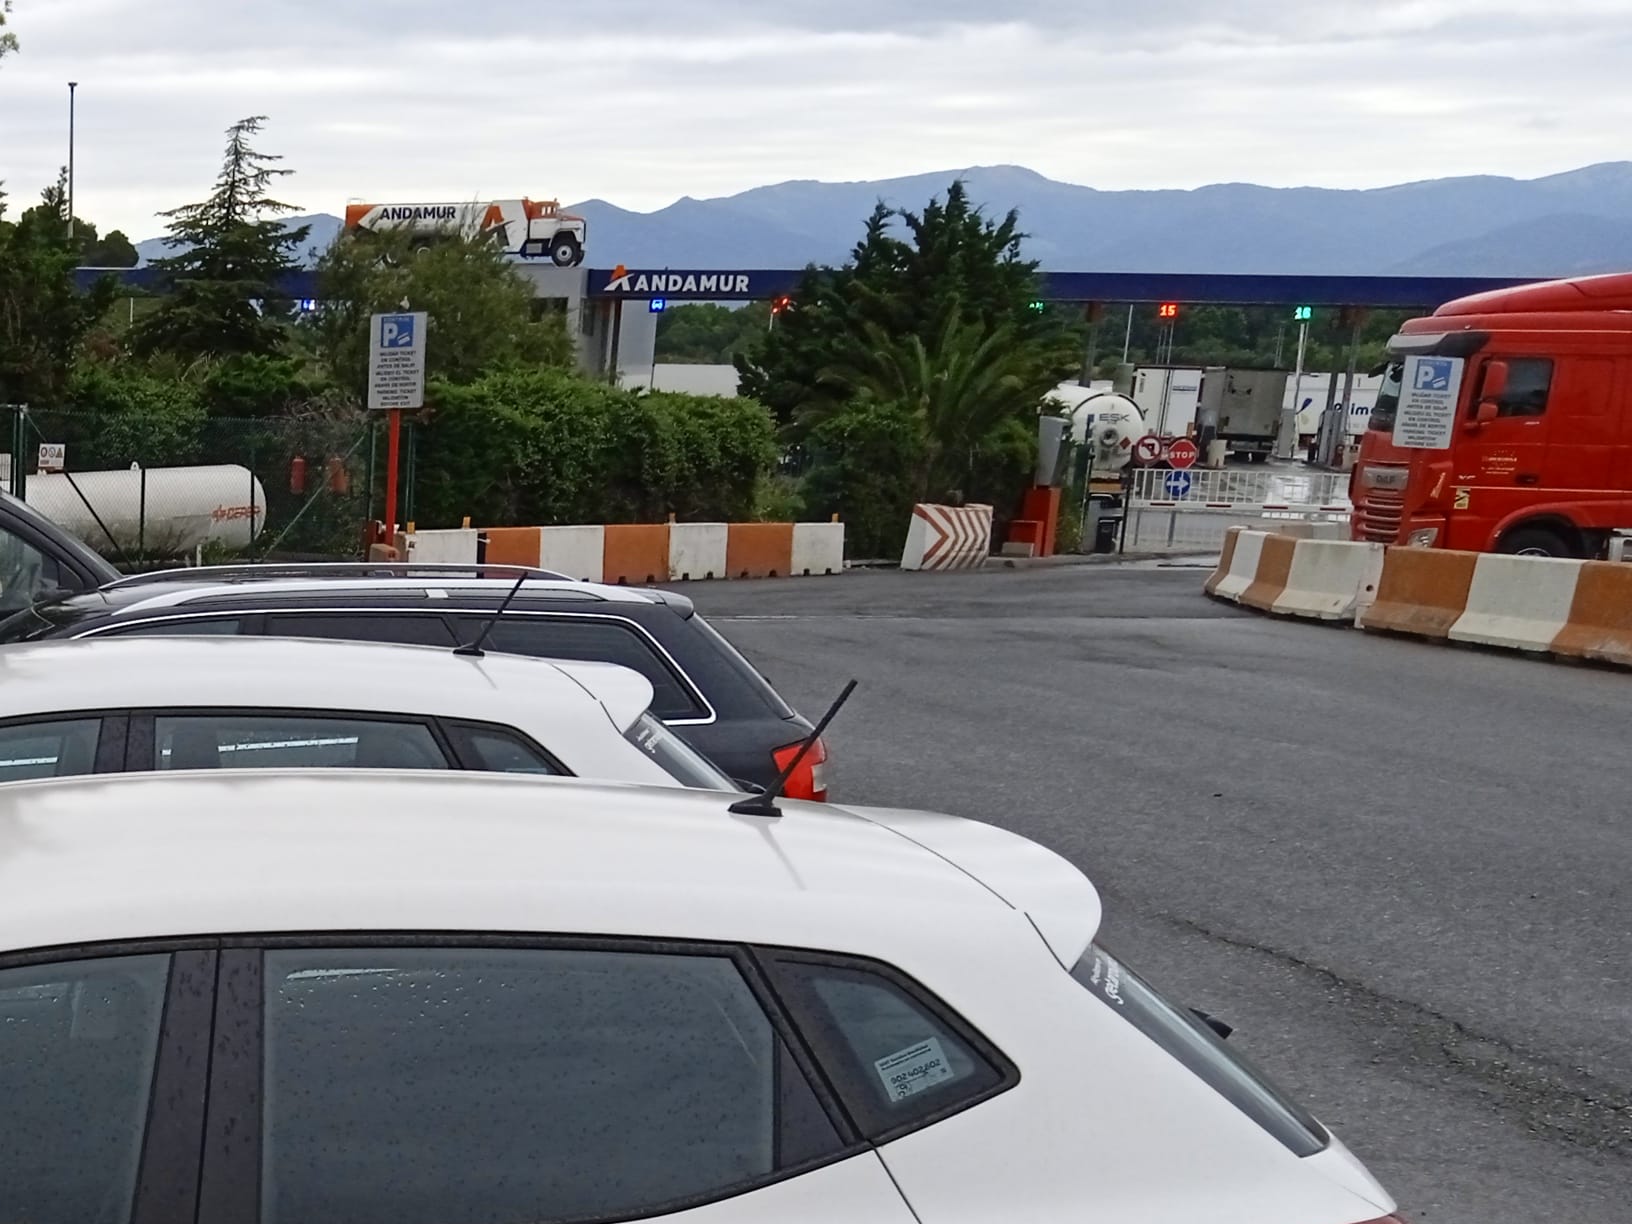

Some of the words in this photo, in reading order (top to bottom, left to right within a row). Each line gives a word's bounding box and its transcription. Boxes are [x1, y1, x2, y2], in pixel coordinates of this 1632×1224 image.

[379, 206, 457, 220] ANDAMUR
[634, 274, 750, 293] ANDAMUR
[1159, 304, 1177, 316] 15
[1294, 306, 1312, 319] 16
[383, 322, 398, 347] P
[1416, 366, 1434, 389] P
[1099, 413, 1130, 422] ESK
[1170, 450, 1196, 459] STOP
